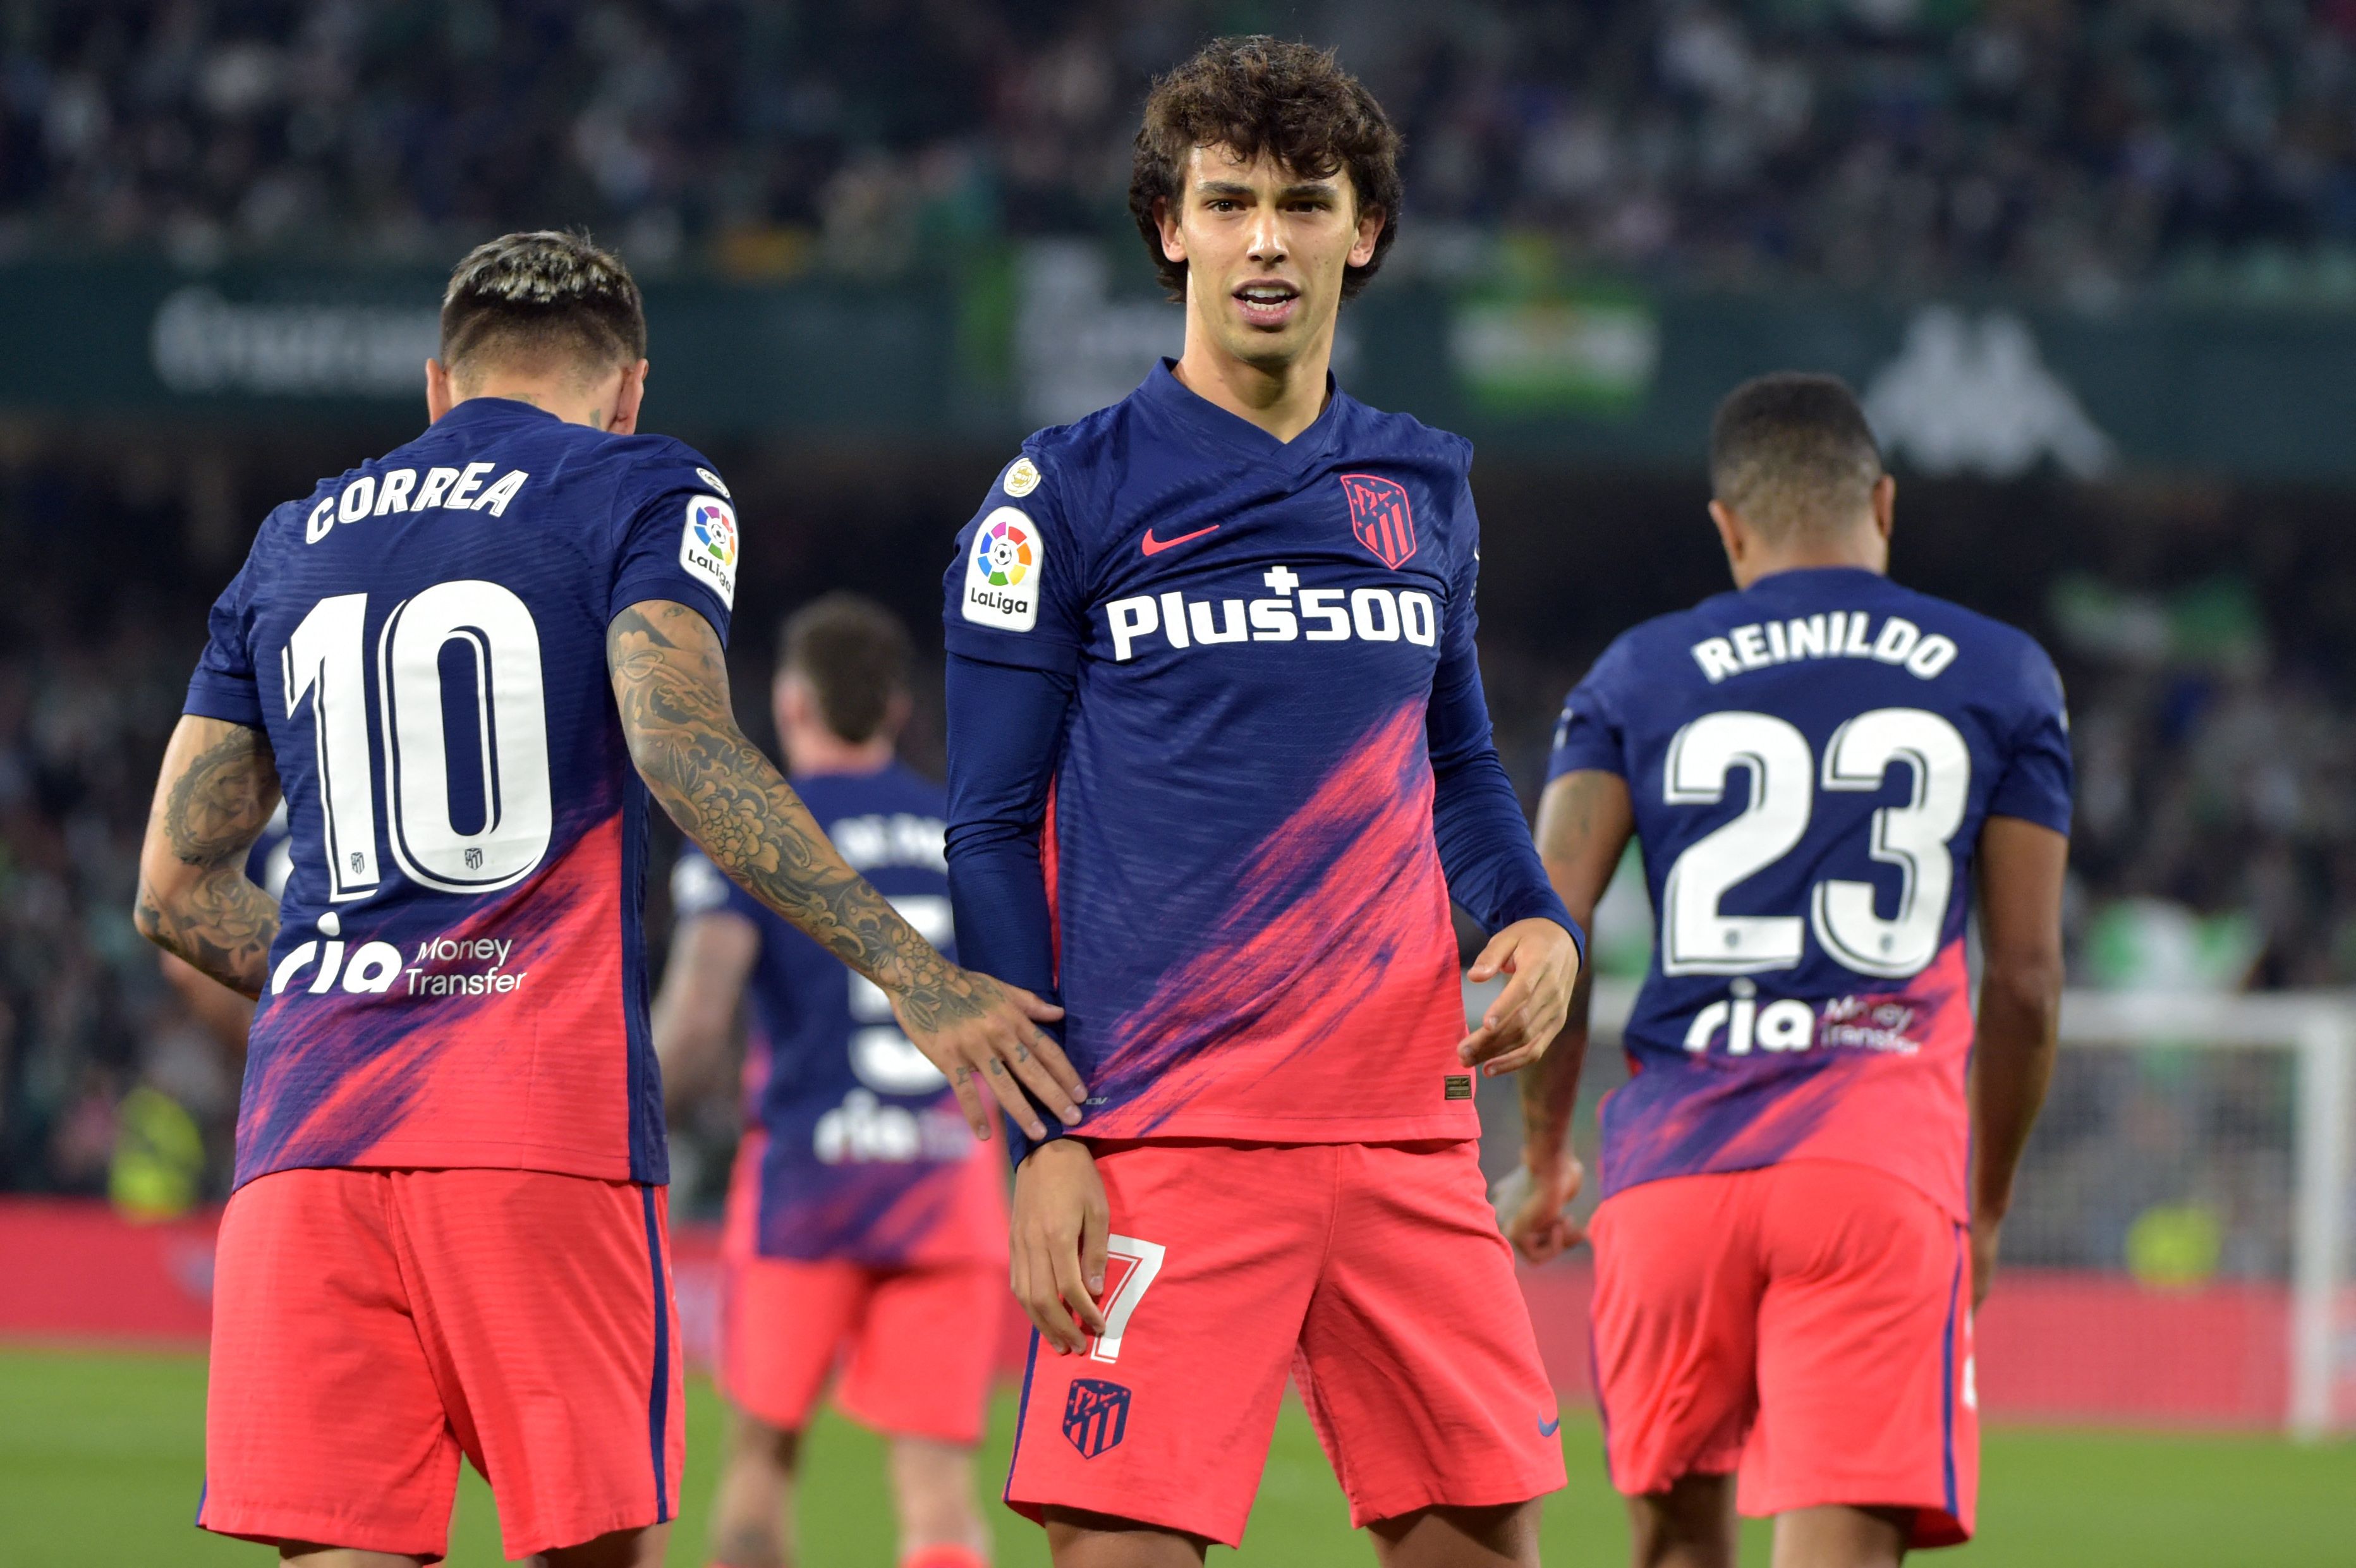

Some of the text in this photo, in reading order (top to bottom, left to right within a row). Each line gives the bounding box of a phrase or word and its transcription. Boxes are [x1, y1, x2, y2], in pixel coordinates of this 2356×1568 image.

[306, 462, 529, 544] CORREA
[688, 549, 732, 594] LaLiga
[970, 587, 1028, 614] LaLiga
[1105, 566, 1435, 662] Plus500
[1691, 611, 1958, 684] REINILDO
[281, 580, 552, 903] 10
[1662, 707, 1972, 977] 23
[271, 911, 403, 995] ria
[405, 966, 528, 996] Transfer
[415, 936, 513, 968] Money
[1683, 976, 1814, 1055] ria
[1090, 1233, 1166, 1364] 7
